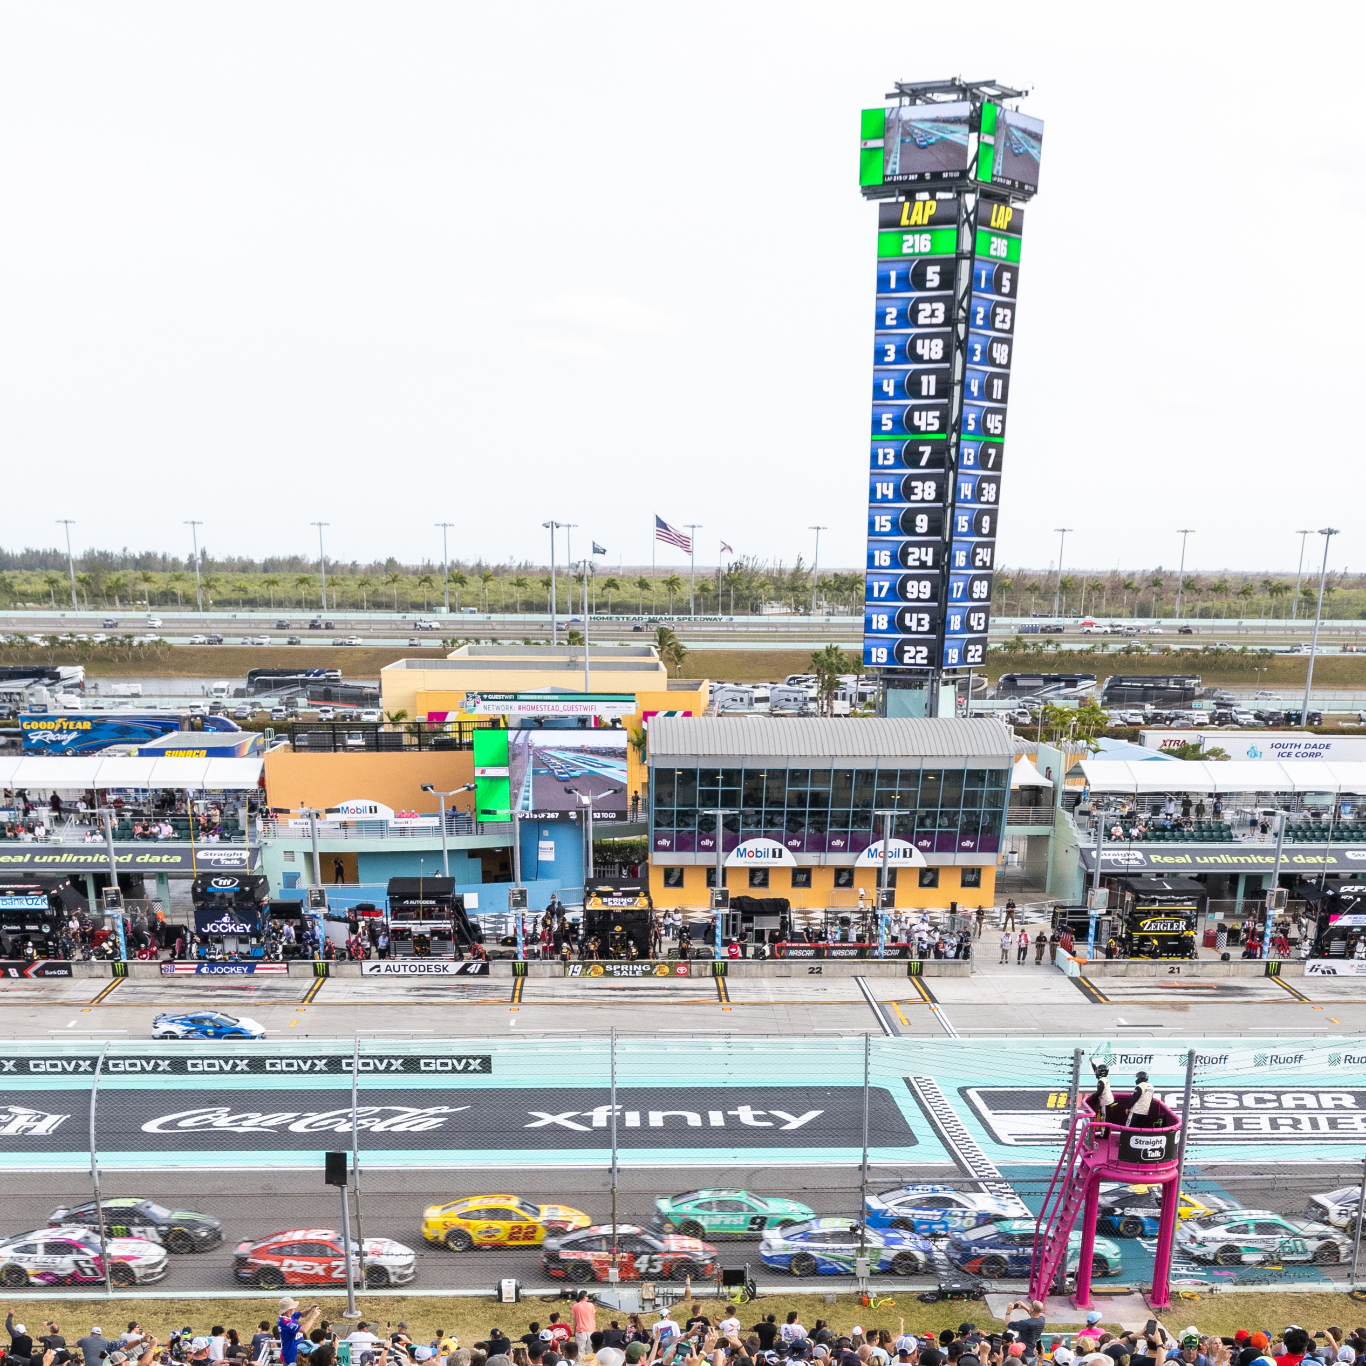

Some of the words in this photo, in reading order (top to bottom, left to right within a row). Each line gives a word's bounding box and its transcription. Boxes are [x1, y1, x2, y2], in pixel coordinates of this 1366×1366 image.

[900, 200, 936, 226] LAP
[902, 234, 931, 253] 216
[989, 237, 1008, 258] 216
[890, 270, 896, 288] 1
[926, 266, 940, 287] 5
[886, 307, 897, 325] 2
[917, 303, 945, 324] 23
[884, 344, 896, 362] 3
[916, 339, 943, 360] 48
[882, 379, 894, 397] 4
[920, 375, 935, 395] 11
[881, 414, 893, 430] 5
[914, 411, 940, 431] 45
[877, 448, 895, 465] 13
[918, 446, 932, 466] 7
[875, 483, 894, 499] 14
[910, 481, 936, 500] 38
[874, 515, 891, 532] 15
[915, 514, 929, 533] 9
[874, 550, 891, 566] 16
[907, 547, 933, 566] 24
[872, 581, 890, 597] 17
[906, 580, 931, 599] 99
[871, 614, 888, 630] 18
[904, 613, 930, 632] 43
[871, 648, 888, 663] 19
[903, 646, 928, 664] 22
[22, 718, 93, 731] GOODYEAR
[28, 732, 82, 744] Racing
[1161, 739, 1186, 748] XTRA
[165, 750, 207, 758] SUNOCO
[34, 853, 134, 863] unlimited
[137, 853, 182, 864] data
[736, 847, 770, 858] Mobil
[772, 848, 782, 858] 1
[201, 922, 251, 932] JOCKEY
[1143, 921, 1186, 932] ZEIGLER
[210, 965, 248, 973] JOCKEY
[384, 964, 449, 973] AUTODESK
[466, 964, 482, 973] 41
[568, 965, 582, 976] 19
[808, 966, 823, 974] 22
[1120, 1055, 1153, 1064] Ruoff
[523, 1105, 825, 1131] xfinity
[1135, 1138, 1162, 1146] Straight
[1147, 1149, 1161, 1157] Talk
[749, 1216, 769, 1233] 9
[508, 1226, 538, 1243] 22
[73, 1259, 96, 1277] 6
[634, 1255, 664, 1273] 43
